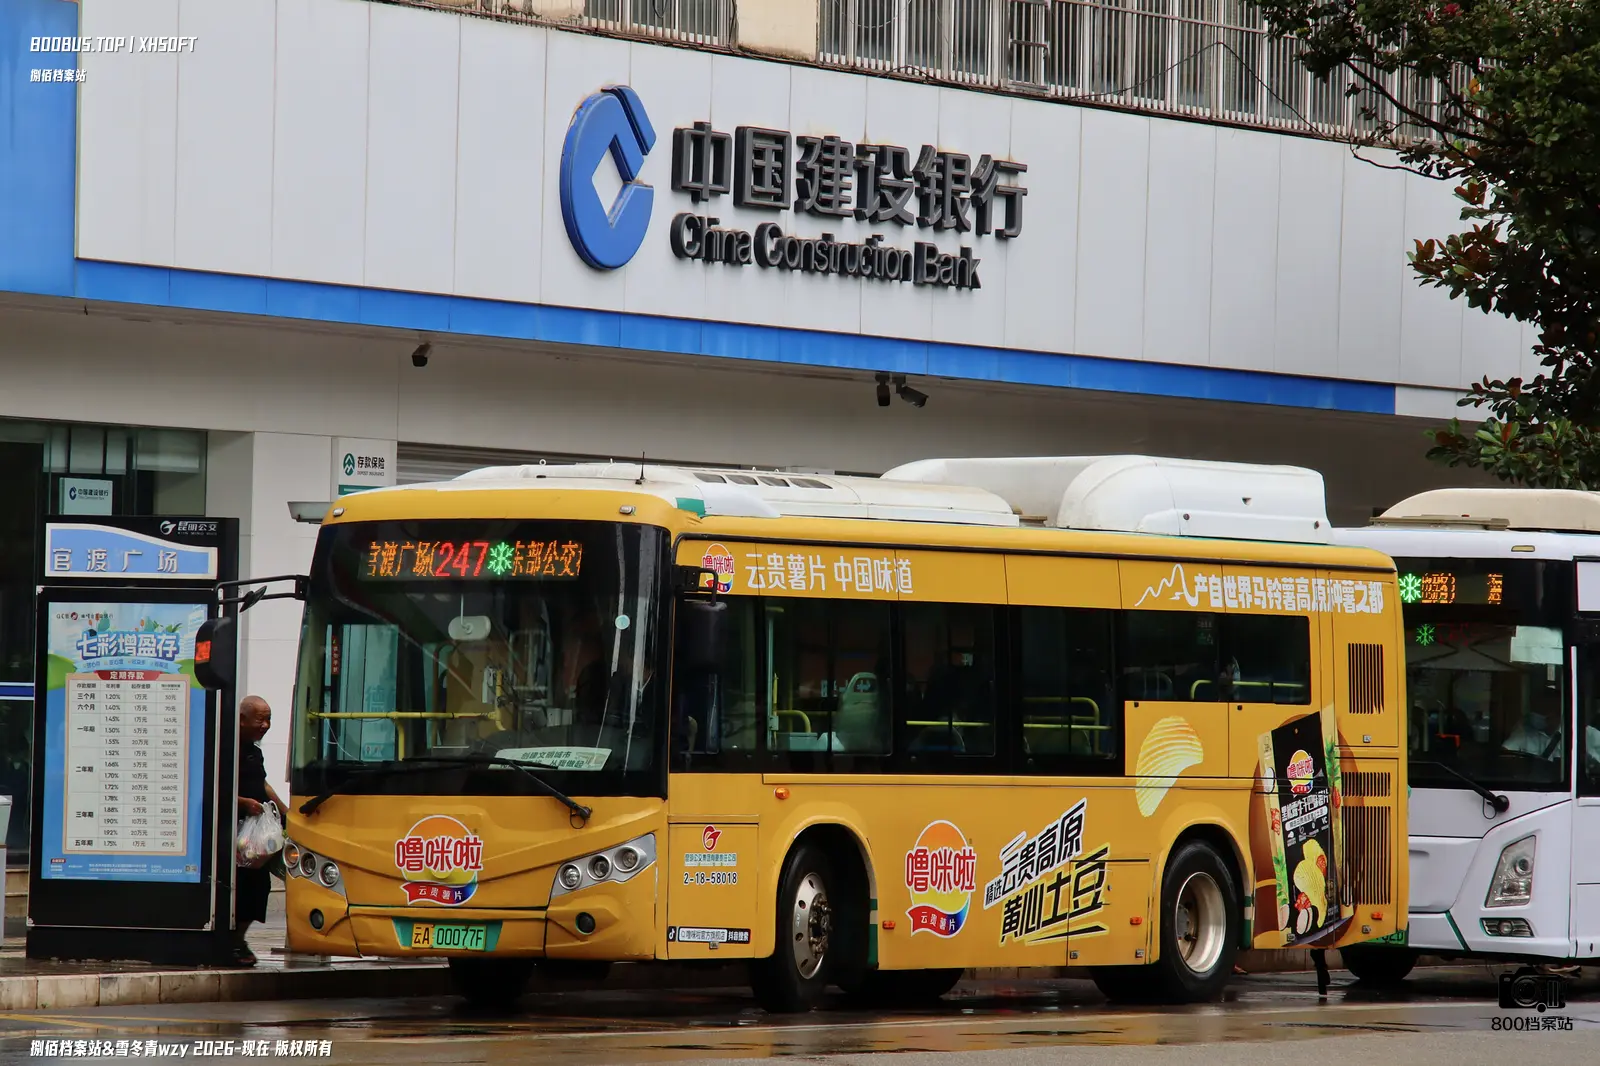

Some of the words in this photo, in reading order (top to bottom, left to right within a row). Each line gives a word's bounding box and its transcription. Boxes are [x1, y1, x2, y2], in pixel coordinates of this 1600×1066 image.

[671, 121, 1028, 239] 中国建设银行
[670, 212, 753, 266] China
[754, 222, 913, 284] Construction
[913, 241, 982, 290] Bank
[357, 456, 386, 470] 存款保险
[178, 521, 217, 532] 昆明公交
[52, 548, 180, 574] 官渡广场
[436, 542, 489, 577] 247
[745, 553, 827, 592] 云贵薯片
[833, 555, 914, 594] 中国味道
[1194, 573, 1384, 614] 产自世界马铃薯高原种薯之都
[77, 633, 179, 659] 七彩增盈存
[109, 671, 145, 680] 定期存款
[77, 692, 96, 700] 三个月
[77, 703, 96, 711] 六个月
[521, 751, 572, 760] 创建文明城市
[75, 765, 94, 773] 二年期
[75, 811, 94, 819] 三年期
[74, 839, 94, 847] 五年期
[395, 836, 483, 872] 噜咪啦
[683, 871, 738, 885] 2-18-58018
[906, 848, 976, 893] 噜咪啦
[418, 885, 463, 901] 云贵薯片
[920, 910, 956, 932] 云贵薯片
[435, 927, 484, 947] 00077F
